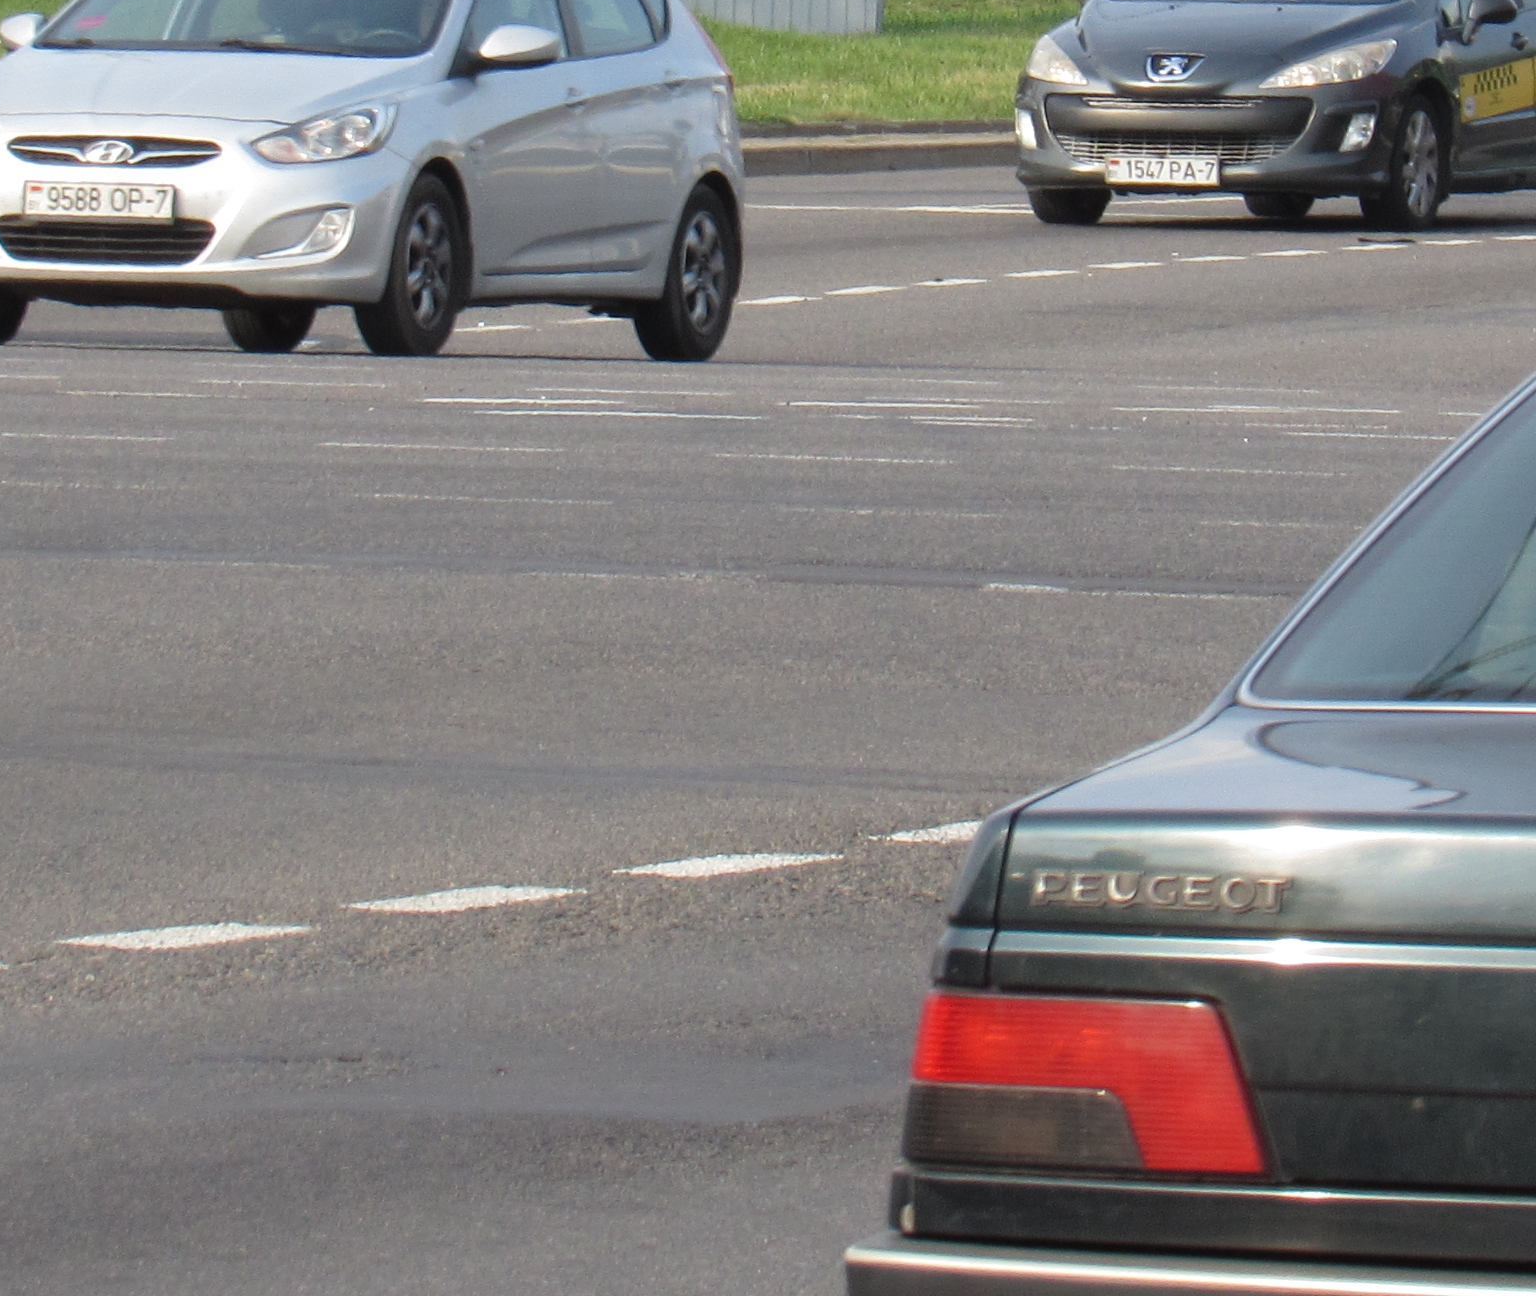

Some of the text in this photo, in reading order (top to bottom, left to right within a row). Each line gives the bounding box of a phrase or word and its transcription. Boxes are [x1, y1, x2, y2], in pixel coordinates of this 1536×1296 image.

[1127, 160, 1164, 179] 1547
[1169, 161, 1216, 181] PA-7
[48, 186, 101, 211] 9588
[110, 187, 169, 213] OP-7
[1030, 870, 1294, 915] PEUGEOT
